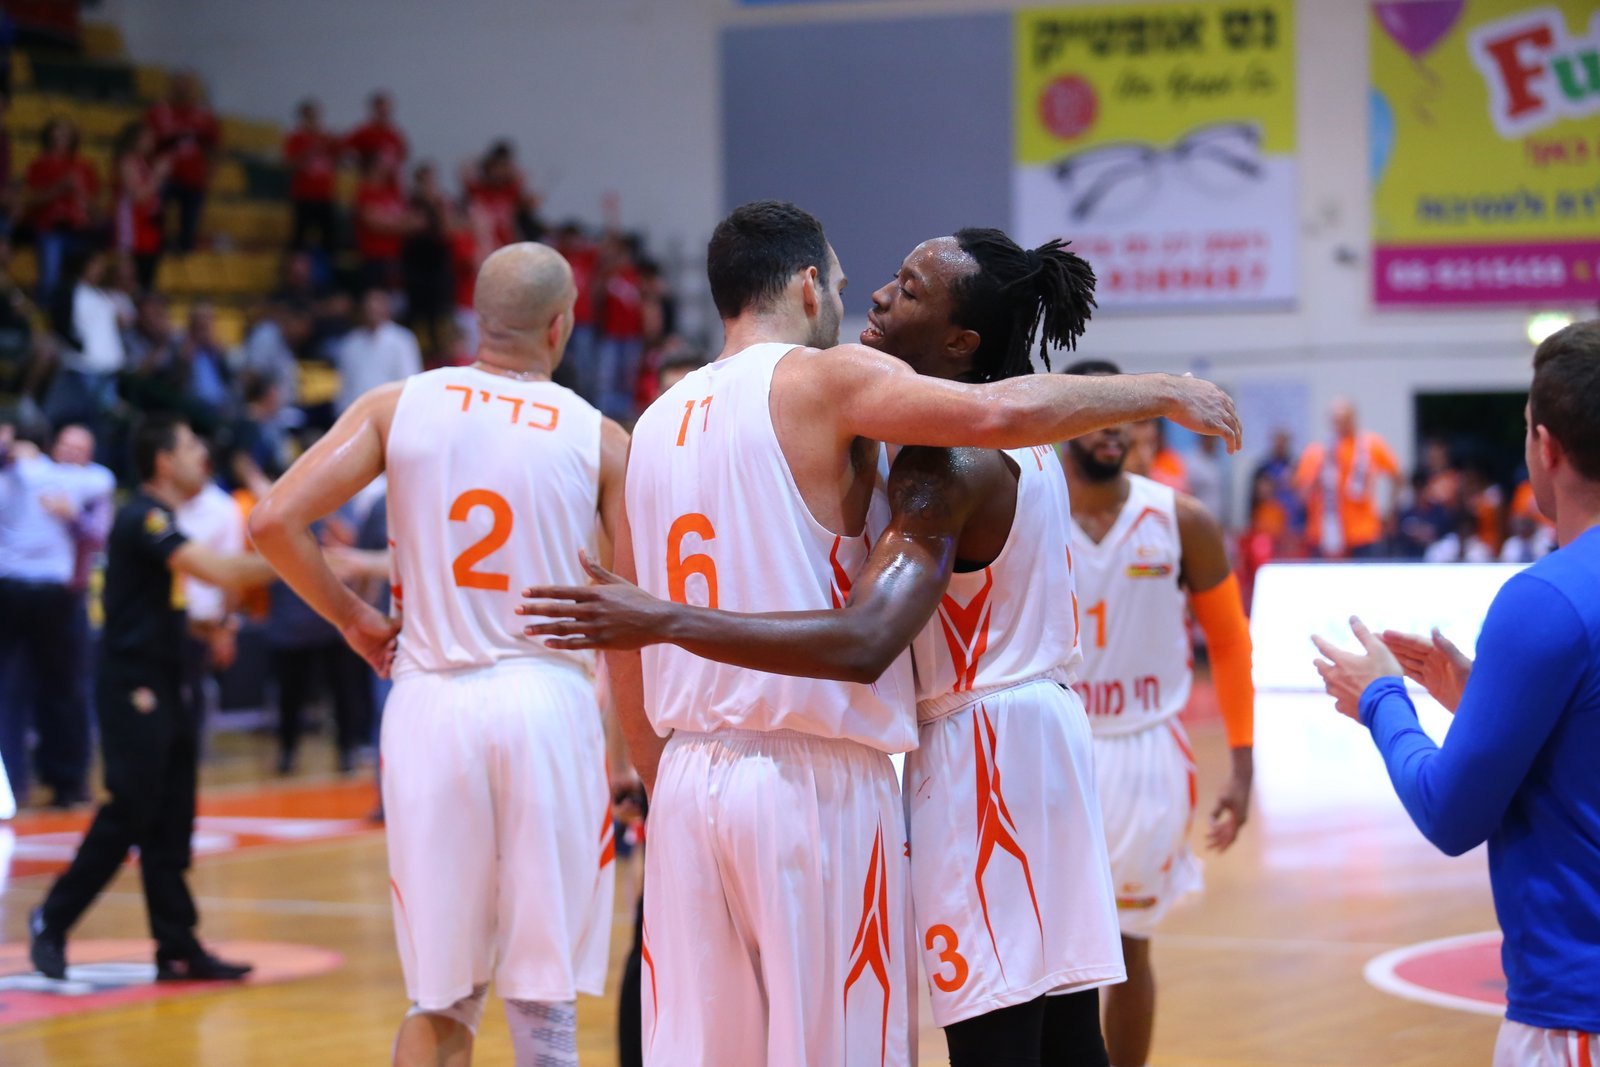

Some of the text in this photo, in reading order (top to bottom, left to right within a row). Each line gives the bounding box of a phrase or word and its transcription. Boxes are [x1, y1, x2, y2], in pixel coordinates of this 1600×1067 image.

[445, 385, 560, 431] כדיר
[448, 488, 514, 592] 2
[666, 512, 719, 610] 6
[1086, 600, 1107, 650] 1
[925, 923, 969, 993] 3
